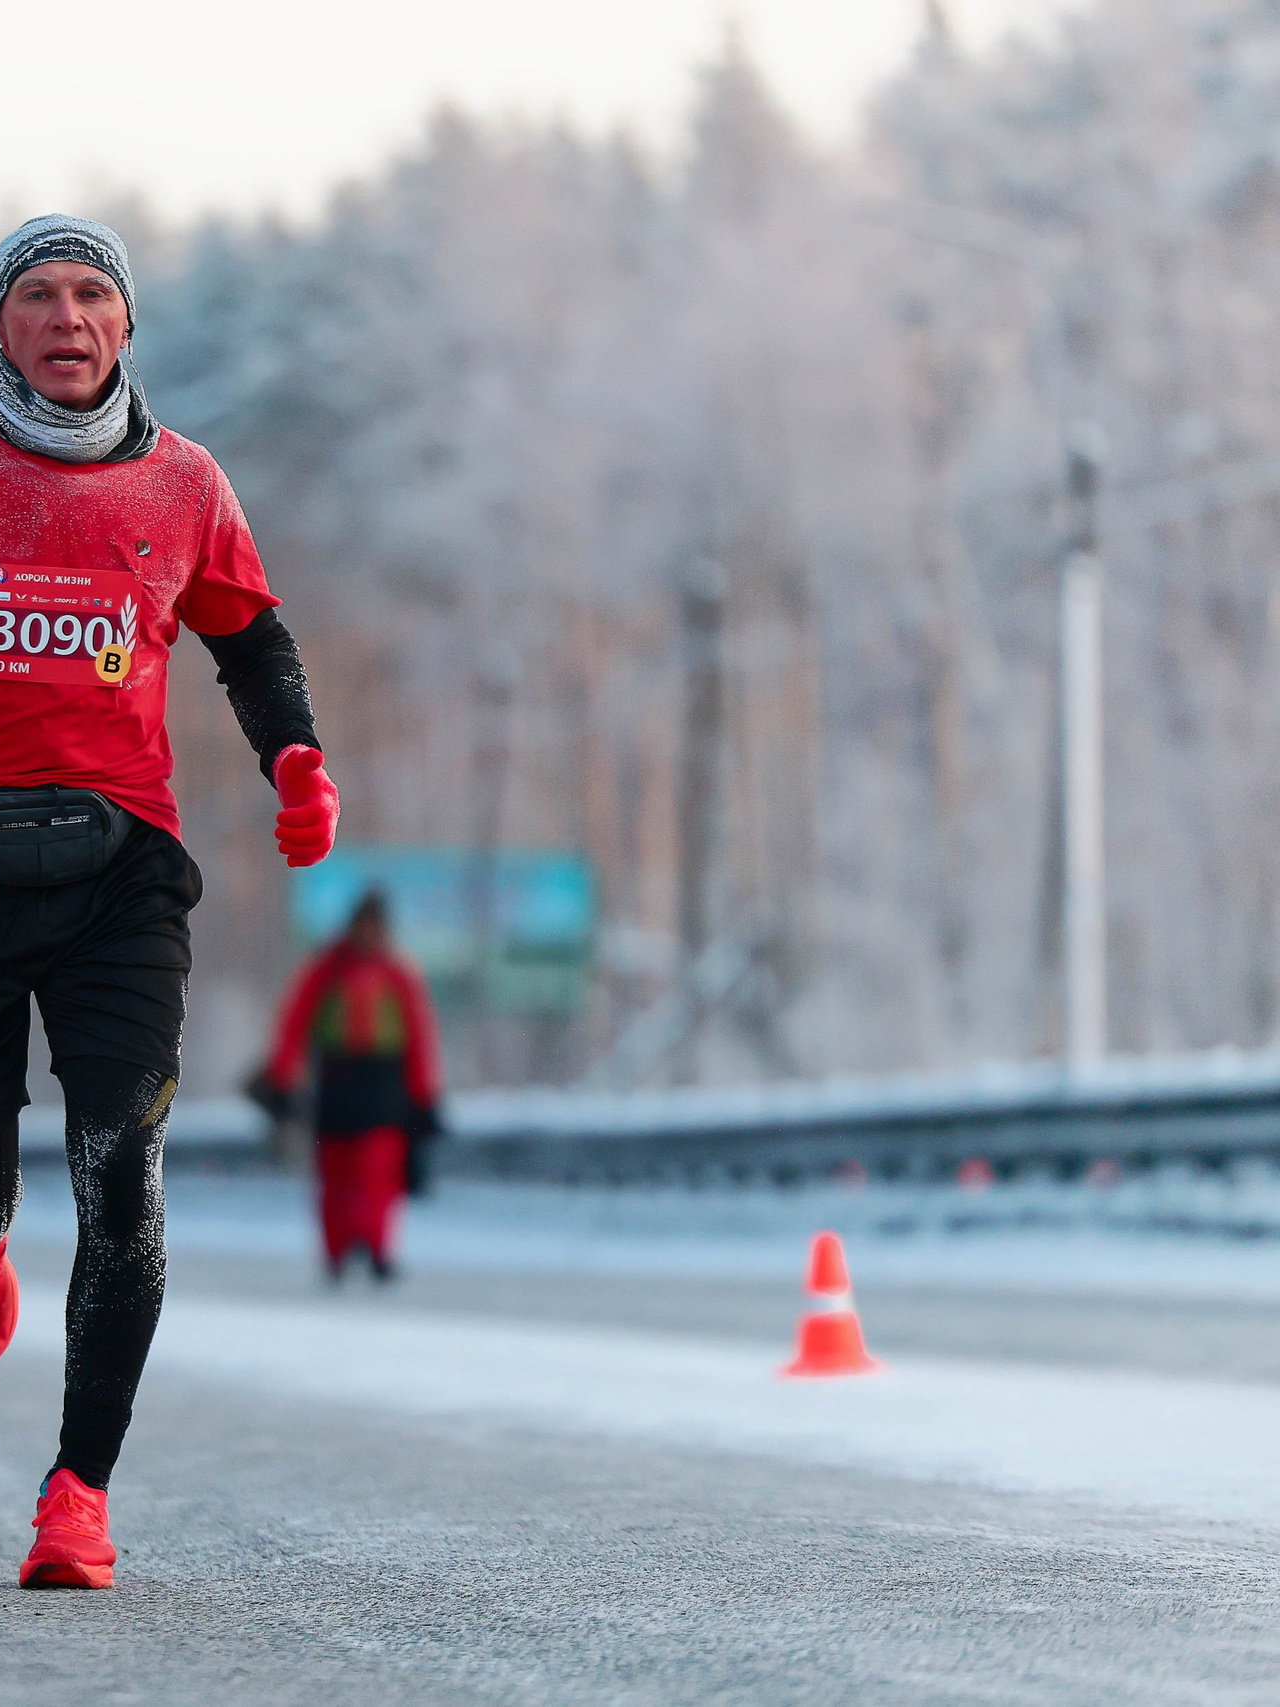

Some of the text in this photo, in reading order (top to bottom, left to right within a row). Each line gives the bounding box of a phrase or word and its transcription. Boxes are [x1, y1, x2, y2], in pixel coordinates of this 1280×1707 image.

[14, 573, 92, 585] ДОРОГА ЖИЗНИ
[9, 662, 30, 673] КМ
